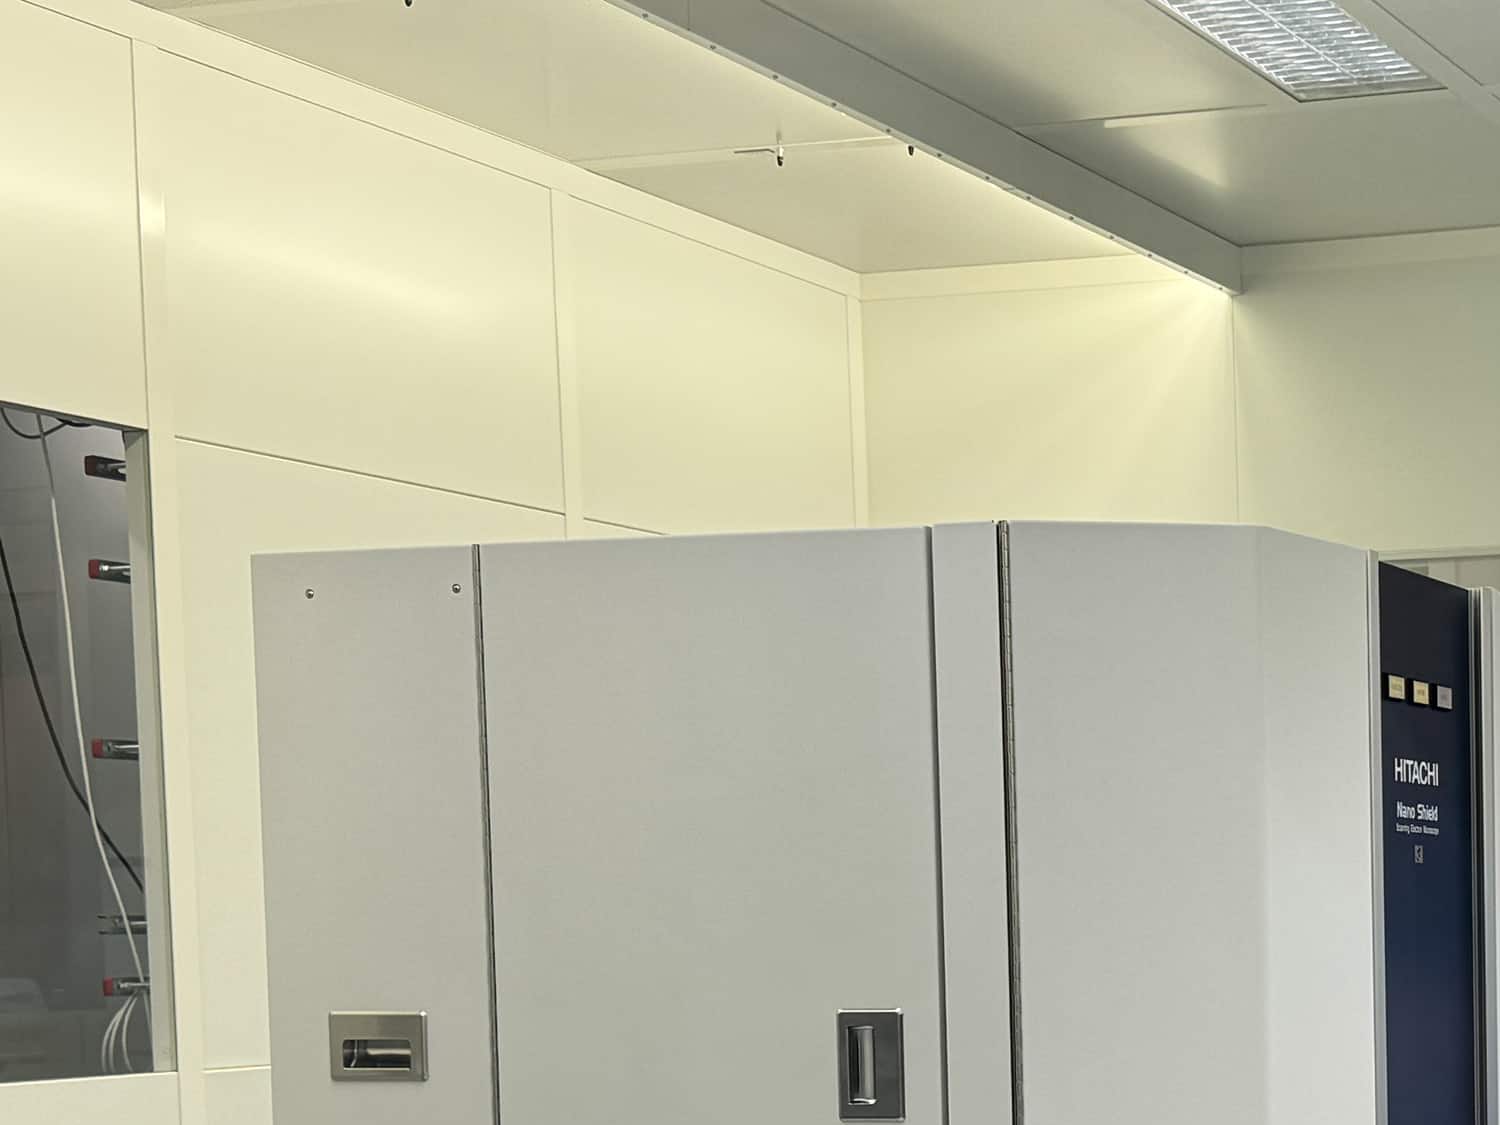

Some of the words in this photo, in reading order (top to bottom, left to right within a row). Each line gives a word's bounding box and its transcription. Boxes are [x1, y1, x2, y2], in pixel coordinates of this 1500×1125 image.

[1394, 757, 1439, 787] HITACHI
[1396, 800, 1416, 820] Nano
[1416, 803, 1439, 822] Shield
